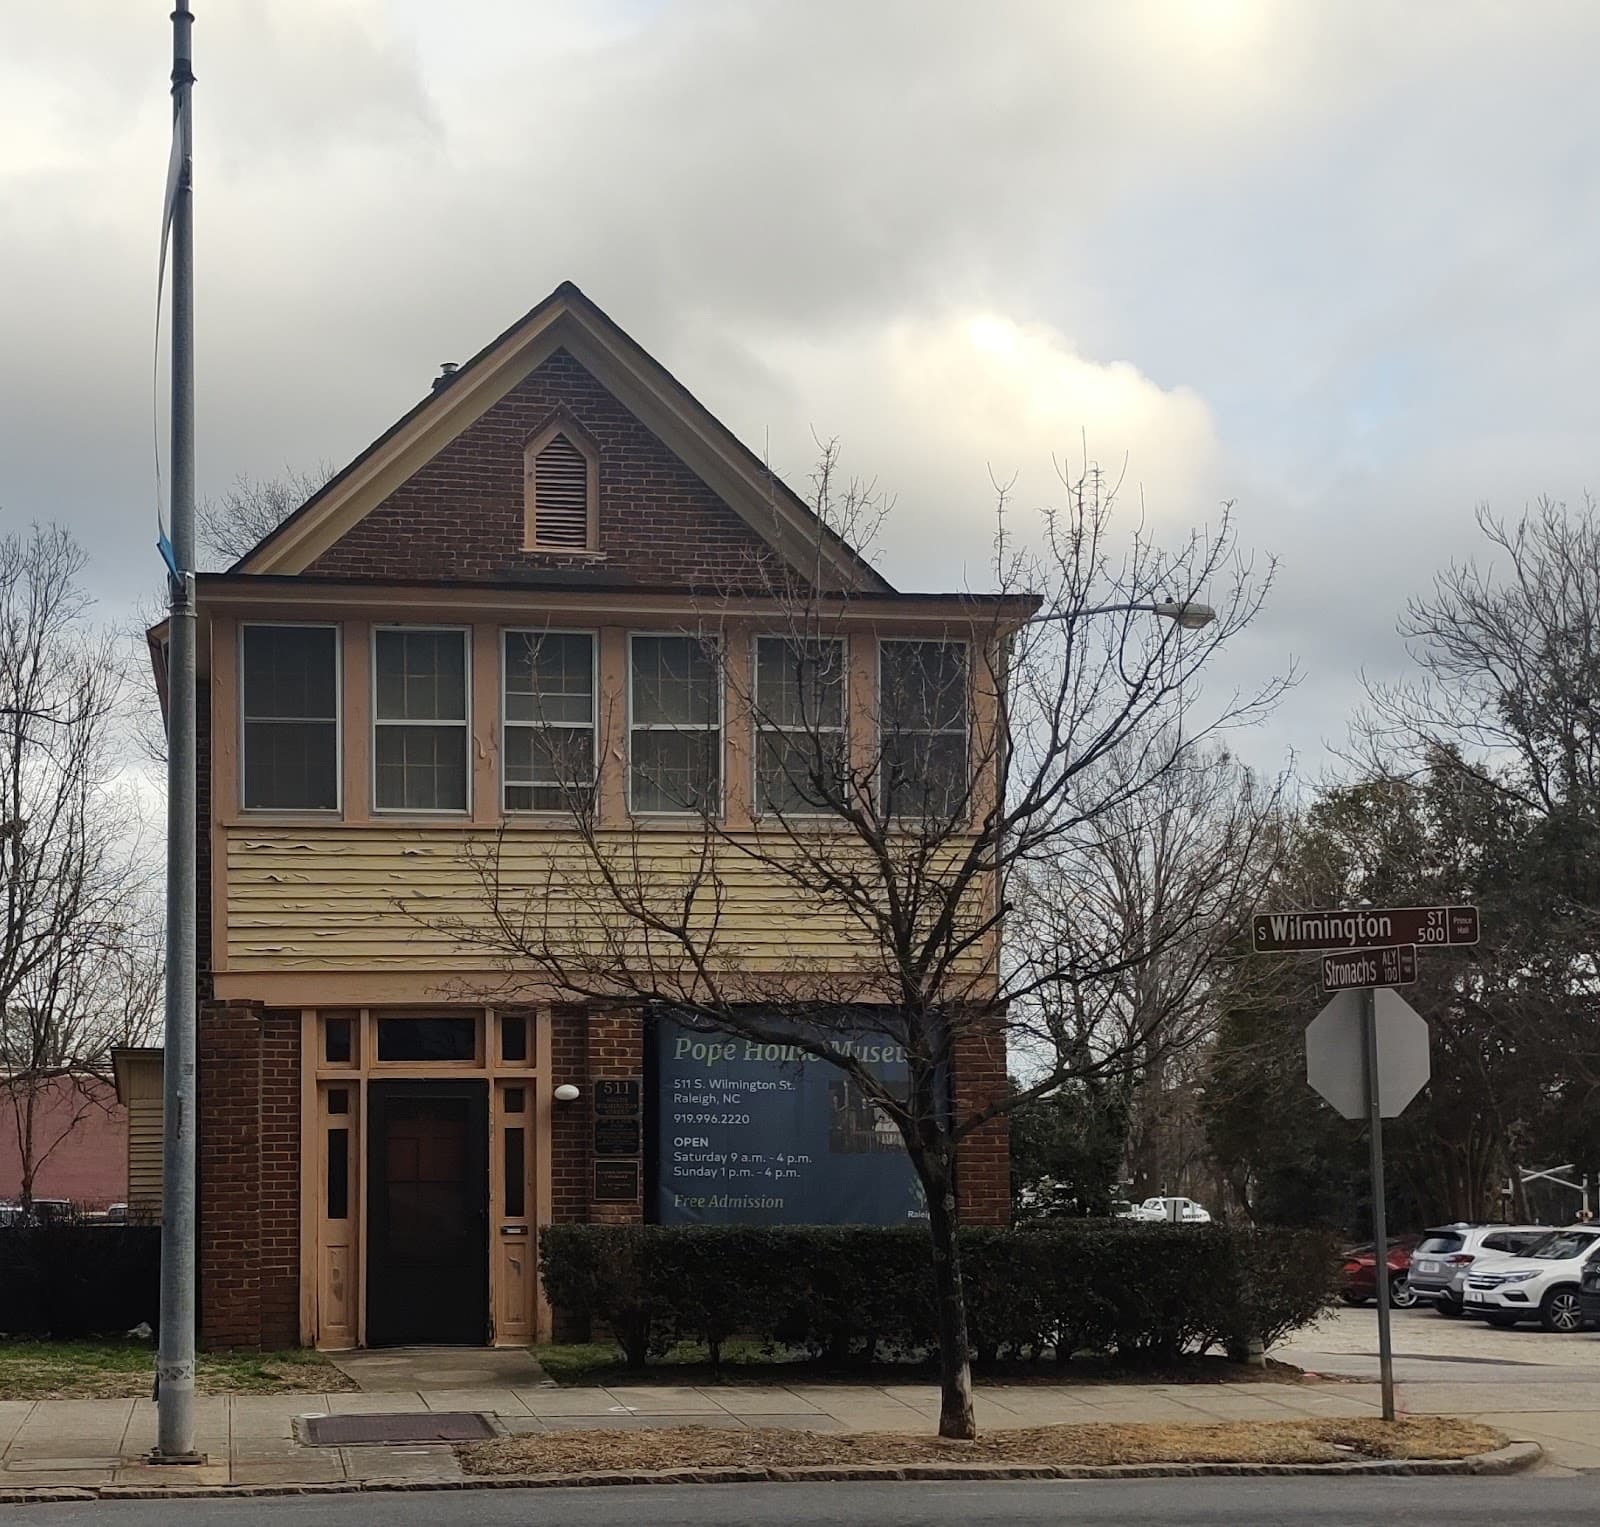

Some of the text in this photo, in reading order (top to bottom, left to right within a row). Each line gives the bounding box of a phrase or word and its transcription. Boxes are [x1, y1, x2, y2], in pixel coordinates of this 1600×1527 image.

[1427, 911, 1444, 926] ST
[1258, 913, 1392, 946] S Wilmington
[1418, 927, 1444, 942] 500
[1382, 949, 1397, 966] ALY
[1325, 956, 1377, 986] Stronachs
[1384, 966, 1398, 982] 100
[673, 1038, 736, 1067] Pope
[604, 1082, 630, 1094] 511
[674, 1079, 796, 1092] 511 S. Wilmington St.
[674, 1093, 741, 1106] Raleigh, NC
[674, 1114, 750, 1124] 919.996.2220
[674, 1137, 709, 1147] OPEN
[673, 1152, 728, 1165] Saturday
[730, 1153, 737, 1163] 9
[740, 1154, 766, 1163] a.m.
[777, 1153, 784, 1163] 4
[787, 1155, 812, 1165] p.m.
[673, 1167, 718, 1180] Sunday
[720, 1167, 725, 1177] 1
[729, 1169, 754, 1179] p.m.
[765, 1168, 772, 1177] 4
[775, 1169, 801, 1179] p.m.
[674, 1194, 784, 1209] Free Admission
